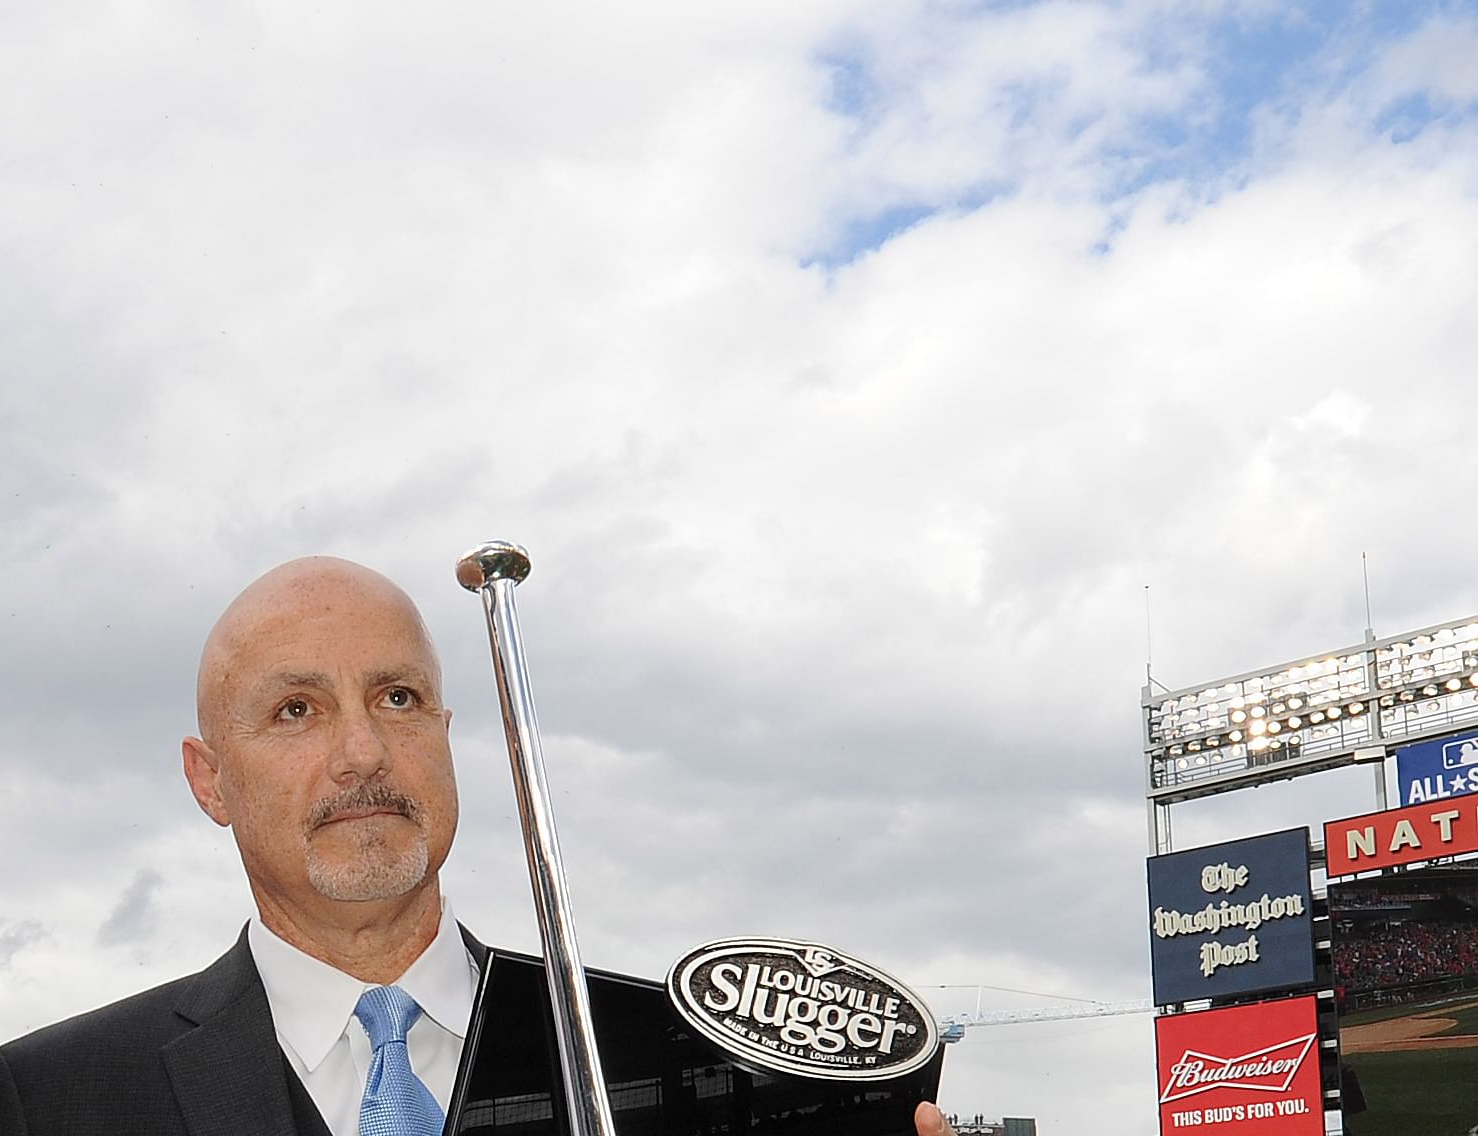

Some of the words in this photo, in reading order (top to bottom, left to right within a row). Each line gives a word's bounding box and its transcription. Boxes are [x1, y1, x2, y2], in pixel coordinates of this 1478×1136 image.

[1409, 775, 1451, 804] ALL
[1346, 805, 1478, 859] NAT
[1201, 862, 1249, 893] The
[1153, 894, 1305, 938] Washington
[1200, 934, 1260, 977] Post
[704, 963, 907, 1054] Slugger
[761, 966, 900, 1020] LOUISVILLE
[723, 1018, 747, 1035] MADE
[748, 1031, 759, 1042] IN
[761, 1036, 779, 1050] THE
[1171, 1056, 1298, 1088] Budweiser
[1172, 1112, 1202, 1127] THIS
[1204, 1106, 1245, 1124] BUD'S
[1248, 1103, 1274, 1120] FOR
[1276, 1099, 1309, 1115] YOU.
